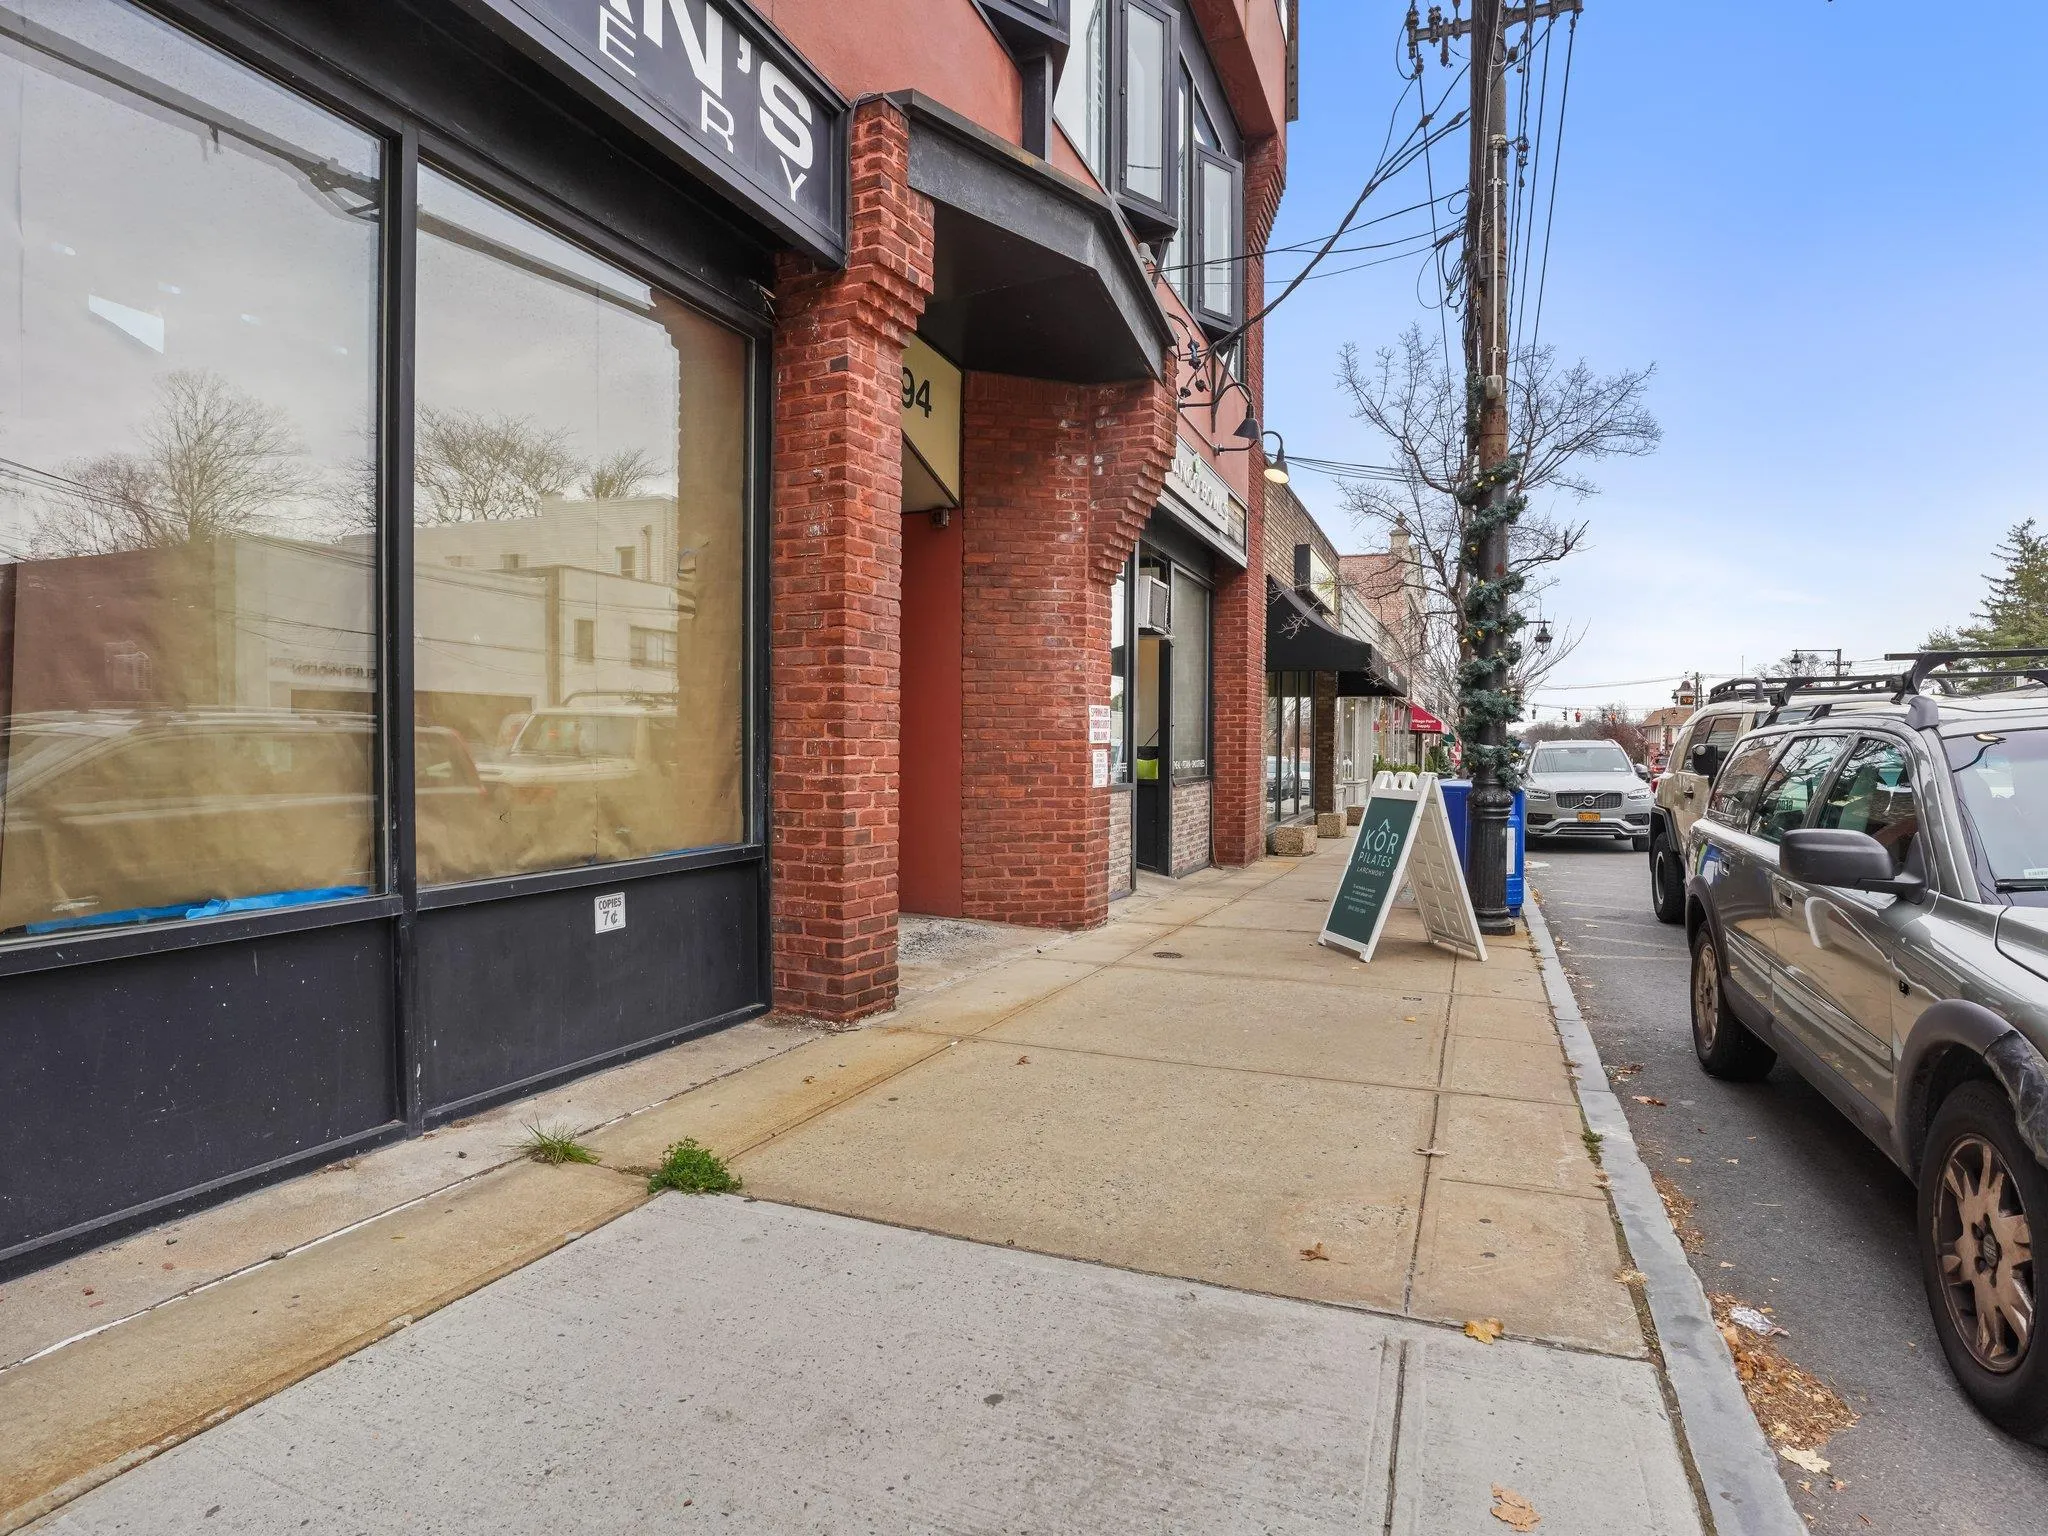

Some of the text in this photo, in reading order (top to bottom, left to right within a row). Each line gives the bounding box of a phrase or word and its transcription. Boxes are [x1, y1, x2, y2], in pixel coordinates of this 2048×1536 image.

[609, 0, 814, 170] N'S
[1357, 851, 1392, 868] PILATES
[598, 897, 622, 910] COPIES
